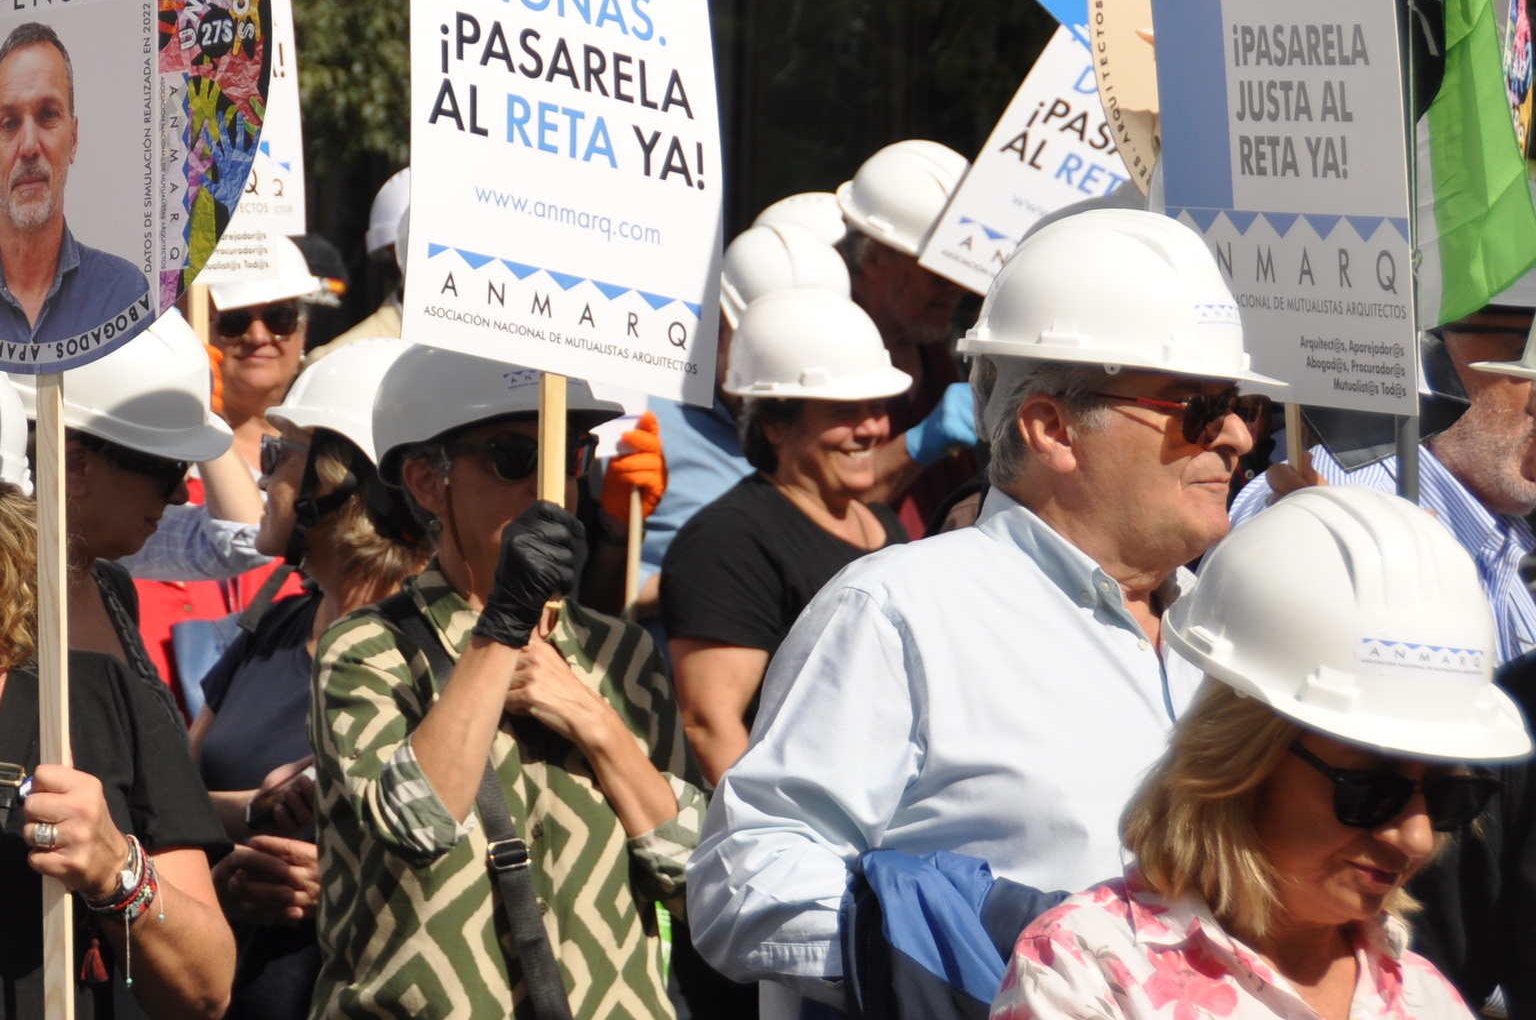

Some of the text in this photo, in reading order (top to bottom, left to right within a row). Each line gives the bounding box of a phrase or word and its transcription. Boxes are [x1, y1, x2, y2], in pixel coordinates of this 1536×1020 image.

[201, 22, 234, 46] 27S
[1232, 24, 1370, 67] ¡PASARELA
[440, 10, 695, 120] ¡PASARELA
[1236, 80, 1353, 122] JUSTA AL
[142, 2, 152, 273] DATOS DE SIMULACIÓN REALIZADA EN 2022
[428, 77, 705, 191] AL RETA YA!
[999, 130, 1047, 170] AL
[1239, 135, 1348, 180] RETA YA!
[475, 186, 661, 245] www.anmarq.com
[1274, 297, 1284, 310] DE
[1287, 298, 1343, 315] MUTUALISTAS
[1346, 303, 1406, 320] ARQUITECTOS
[424, 305, 698, 375] ASOCIACIÓN NACIONAL DE MUTUALISTAS ARQUITECTOS
[1349, 339, 1404, 358] Aparejador@s
[1333, 377, 1406, 397] Mutualist@s Tod@s
[1351, 359, 1405, 378] Procurador@s
